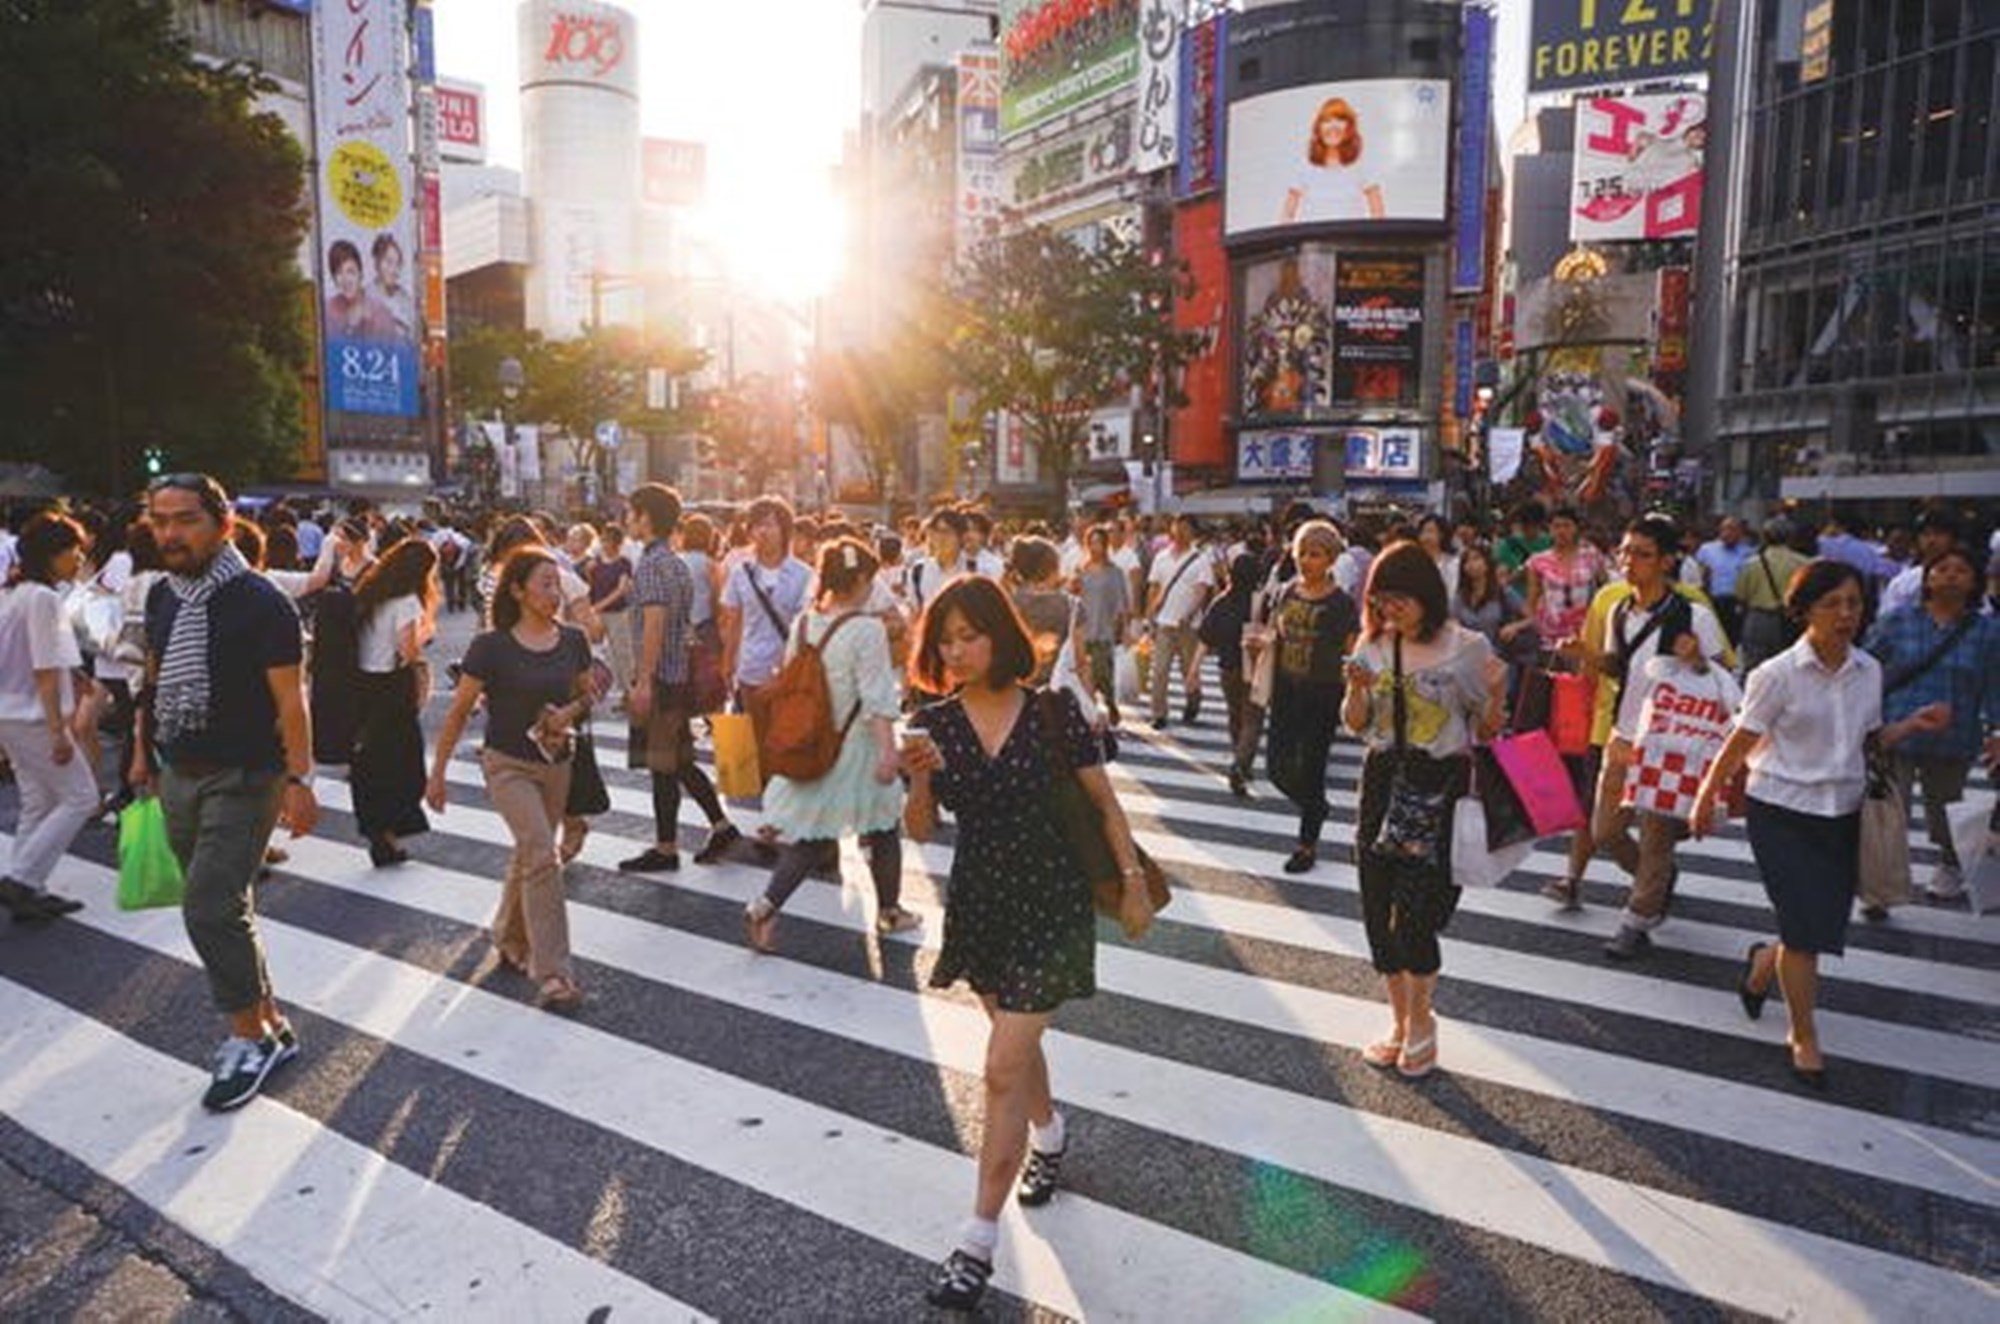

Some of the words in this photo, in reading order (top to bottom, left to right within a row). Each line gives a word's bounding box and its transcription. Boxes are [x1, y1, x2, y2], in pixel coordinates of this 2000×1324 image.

[544, 20, 625, 77] 109
[1535, 26, 1691, 80] FOREVER
[341, 345, 400, 383] 8.24
